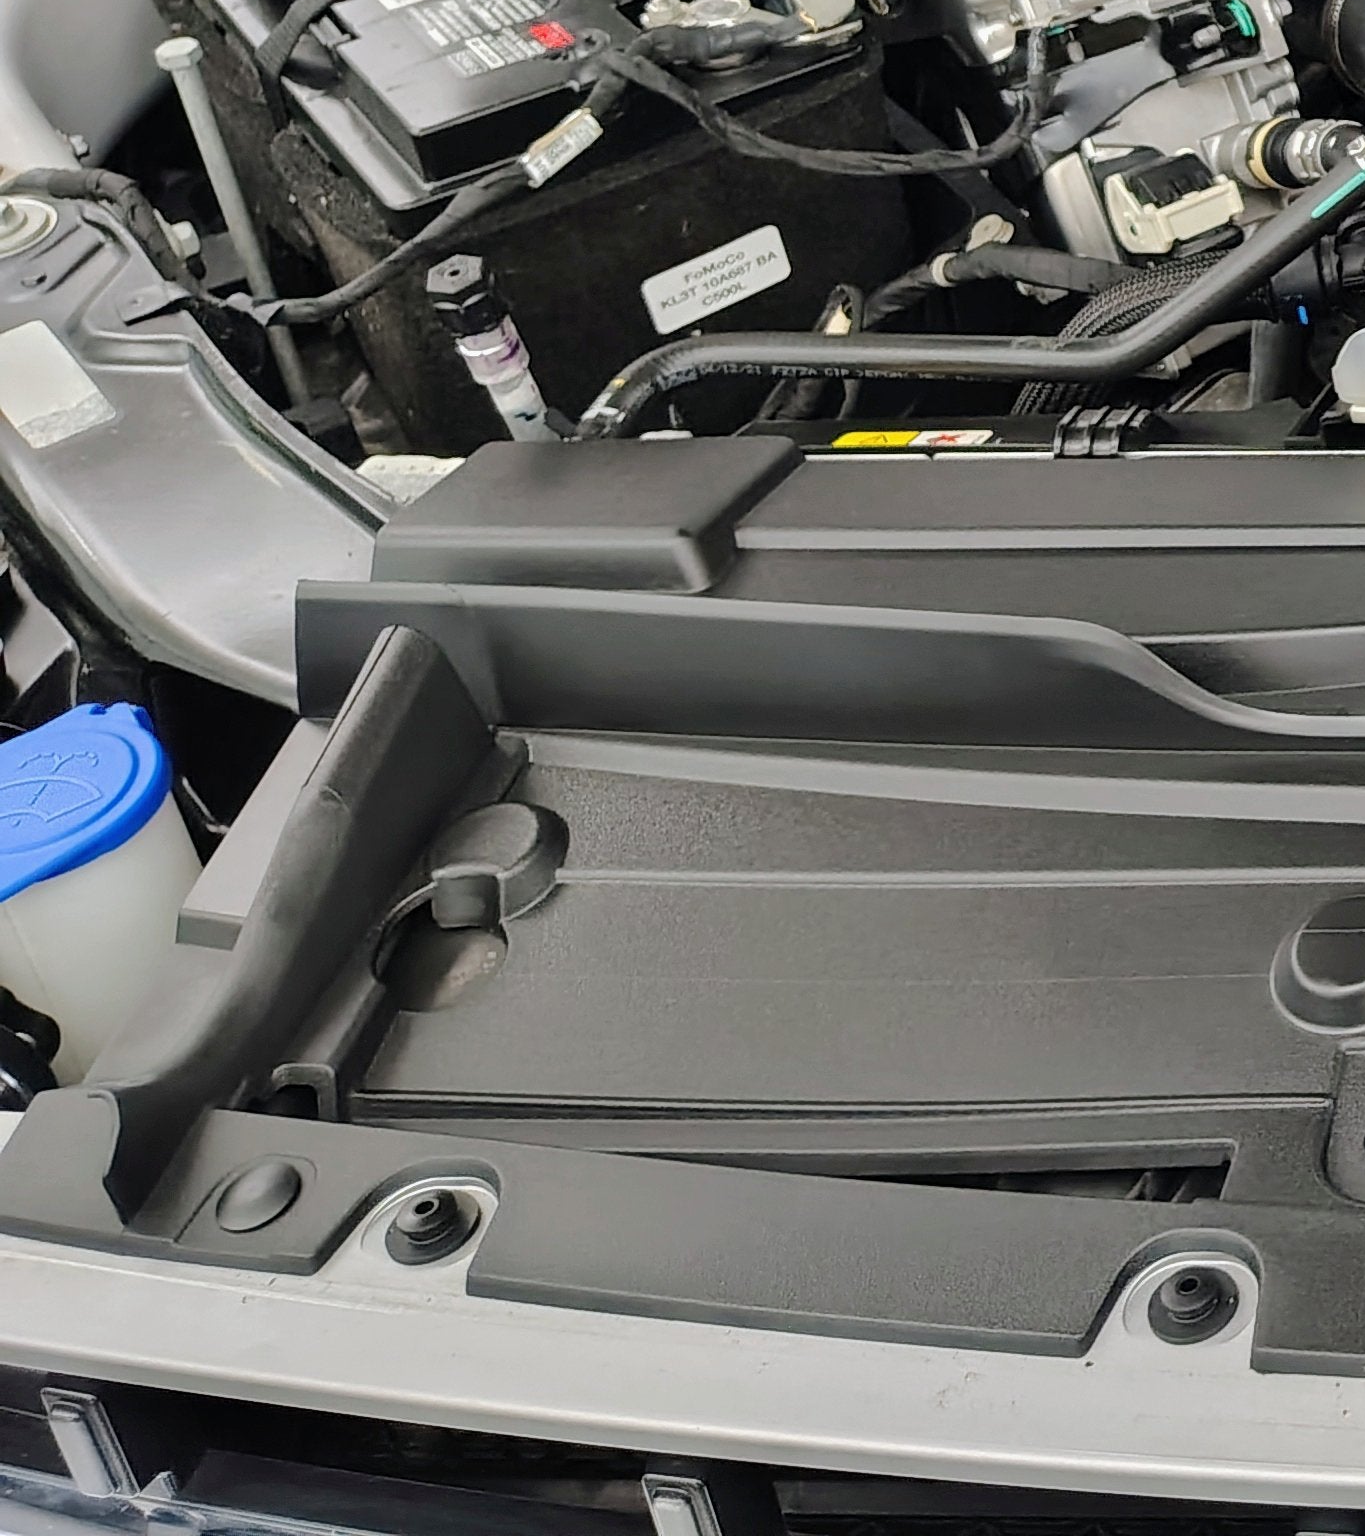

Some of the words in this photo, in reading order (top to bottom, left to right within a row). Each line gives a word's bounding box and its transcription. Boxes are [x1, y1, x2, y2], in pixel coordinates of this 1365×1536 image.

[660, 285, 699, 310] KL3T
[756, 251, 778, 267] BA
[684, 251, 746, 284] FoMoCo
